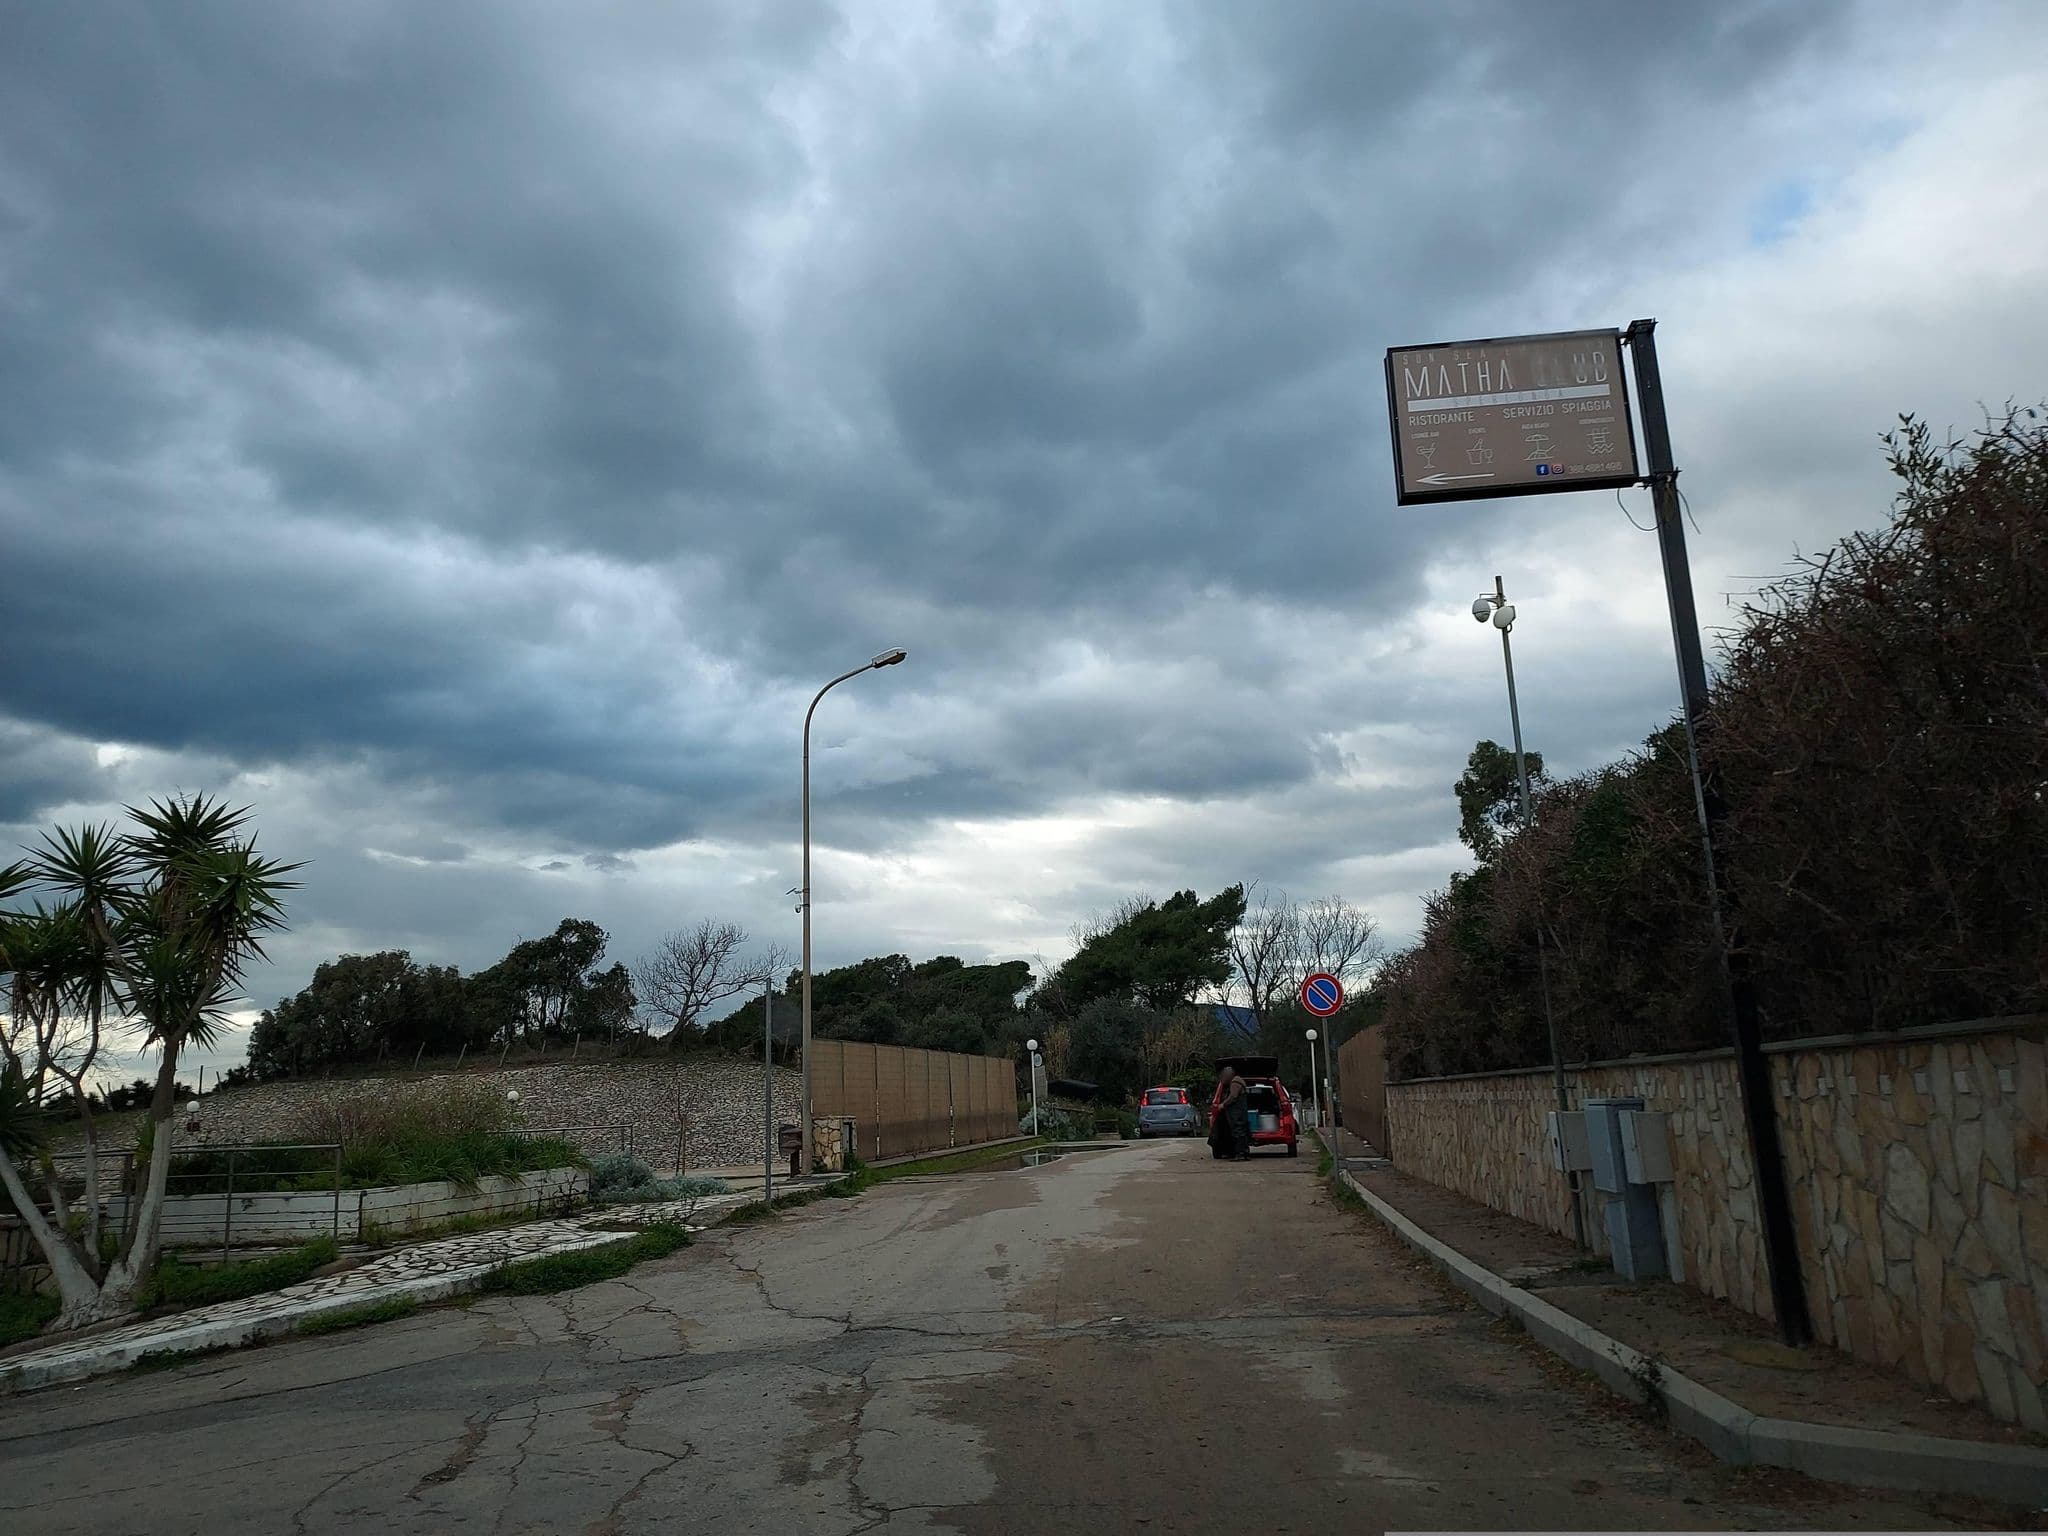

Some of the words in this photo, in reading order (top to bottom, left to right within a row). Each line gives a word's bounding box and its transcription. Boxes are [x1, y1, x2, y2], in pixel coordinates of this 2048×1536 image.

[1405, 359, 1513, 398] MATHA
[1408, 411, 1475, 426] RISTORANTE
[1502, 404, 1555, 419] SERVIZIO
[1561, 400, 1613, 414] SPIAGGIA
